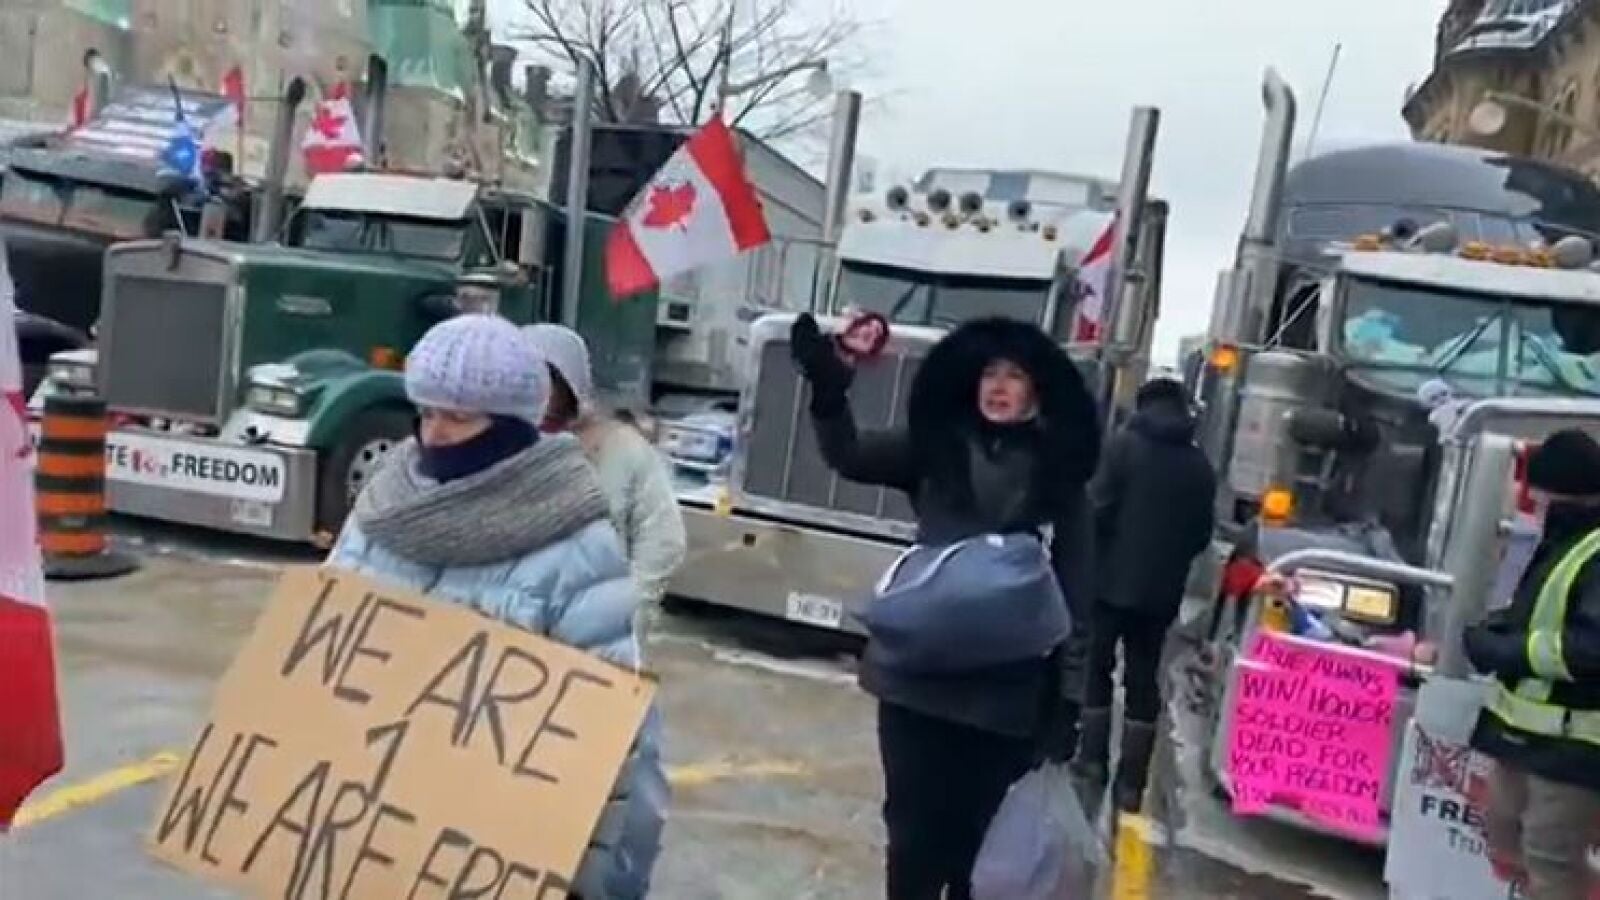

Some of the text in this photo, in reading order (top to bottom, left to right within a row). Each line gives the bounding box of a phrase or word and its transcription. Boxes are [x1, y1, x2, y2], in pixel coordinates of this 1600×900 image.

[172, 453, 279, 488] FREEDOM
[281, 576, 613, 783] WE ARE
[1236, 703, 1346, 742] SOLDIER
[1236, 728, 1373, 775] DEAD FOR
[157, 722, 279, 867] WE
[241, 760, 417, 900] ARE
[1420, 794, 1485, 828] FRE
